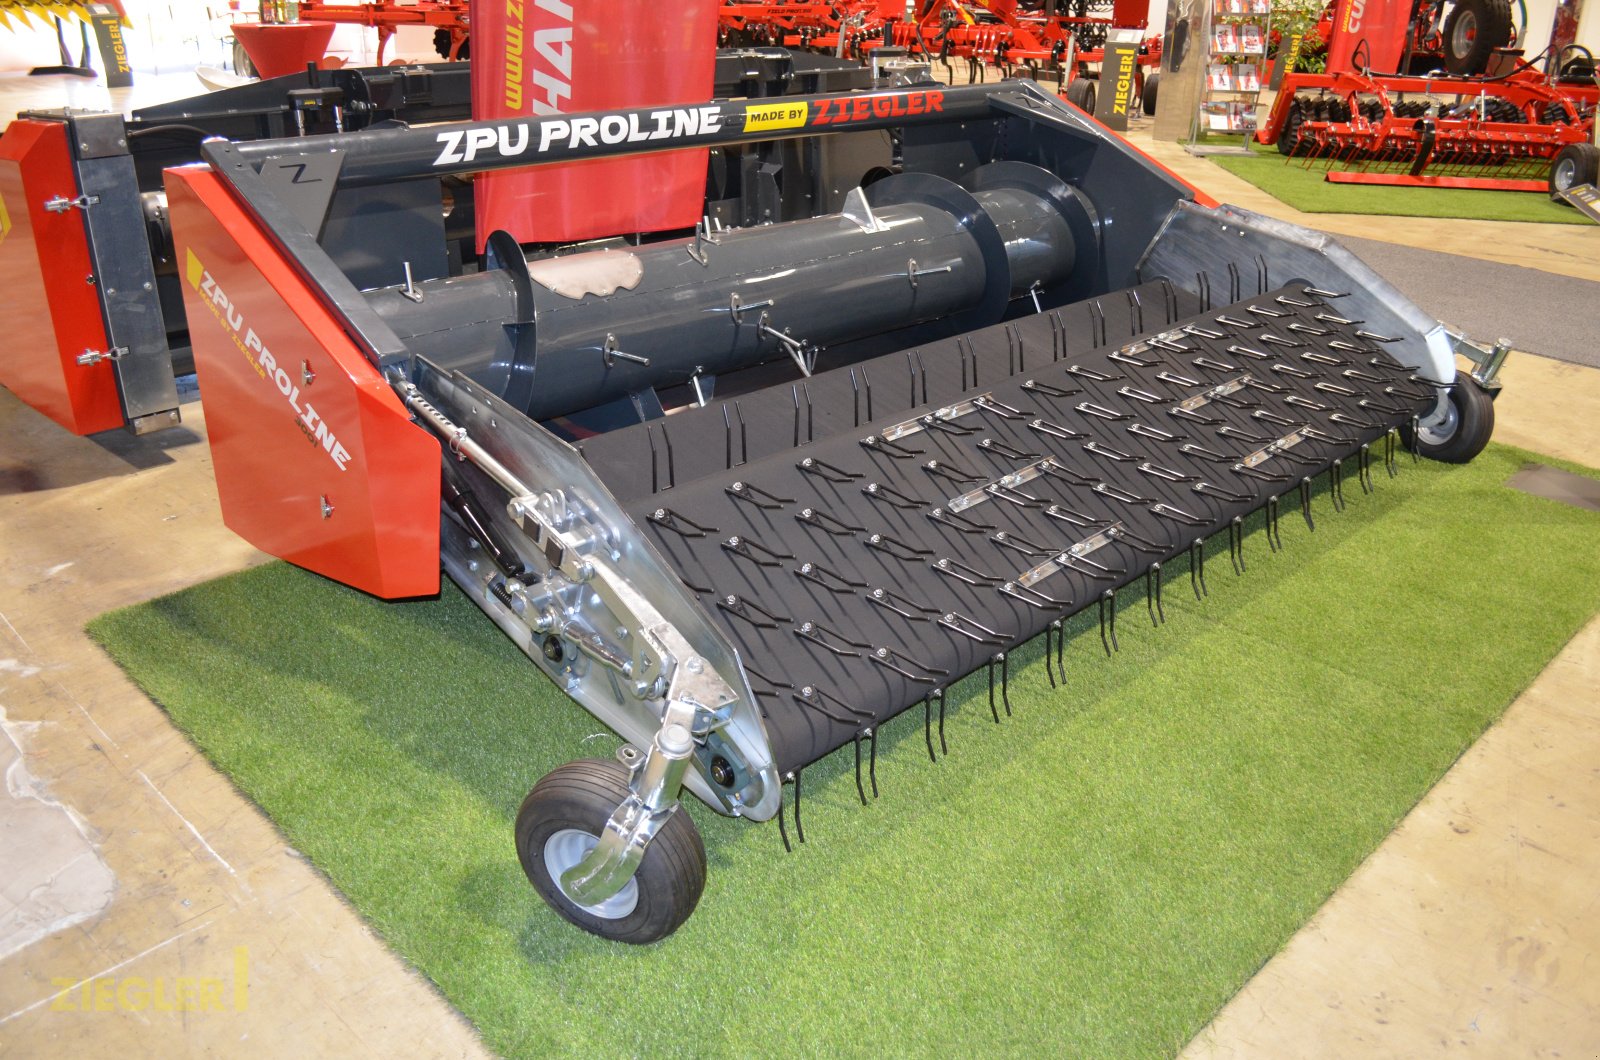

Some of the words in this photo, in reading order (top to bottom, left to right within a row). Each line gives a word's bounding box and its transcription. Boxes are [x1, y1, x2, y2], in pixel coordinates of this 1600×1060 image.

[109, 24, 130, 73] ZIEGLER
[1348, 0, 1367, 33] CU
[505, 0, 523, 110] www.z
[1113, 55, 1134, 115] ZIEGLER
[1284, 37, 1301, 73] IEGLER
[433, 123, 529, 166] ZPU
[538, 106, 722, 152] PROLINE
[750, 110, 785, 123] MADE
[788, 108, 805, 121] BY
[812, 90, 944, 126] ZIEGLER
[199, 290, 220, 318] MADE
[220, 318, 231, 334] BY
[231, 334, 266, 380] ZIEGLER
[200, 271, 243, 331] ZPU
[244, 328, 352, 472] PROLINE
